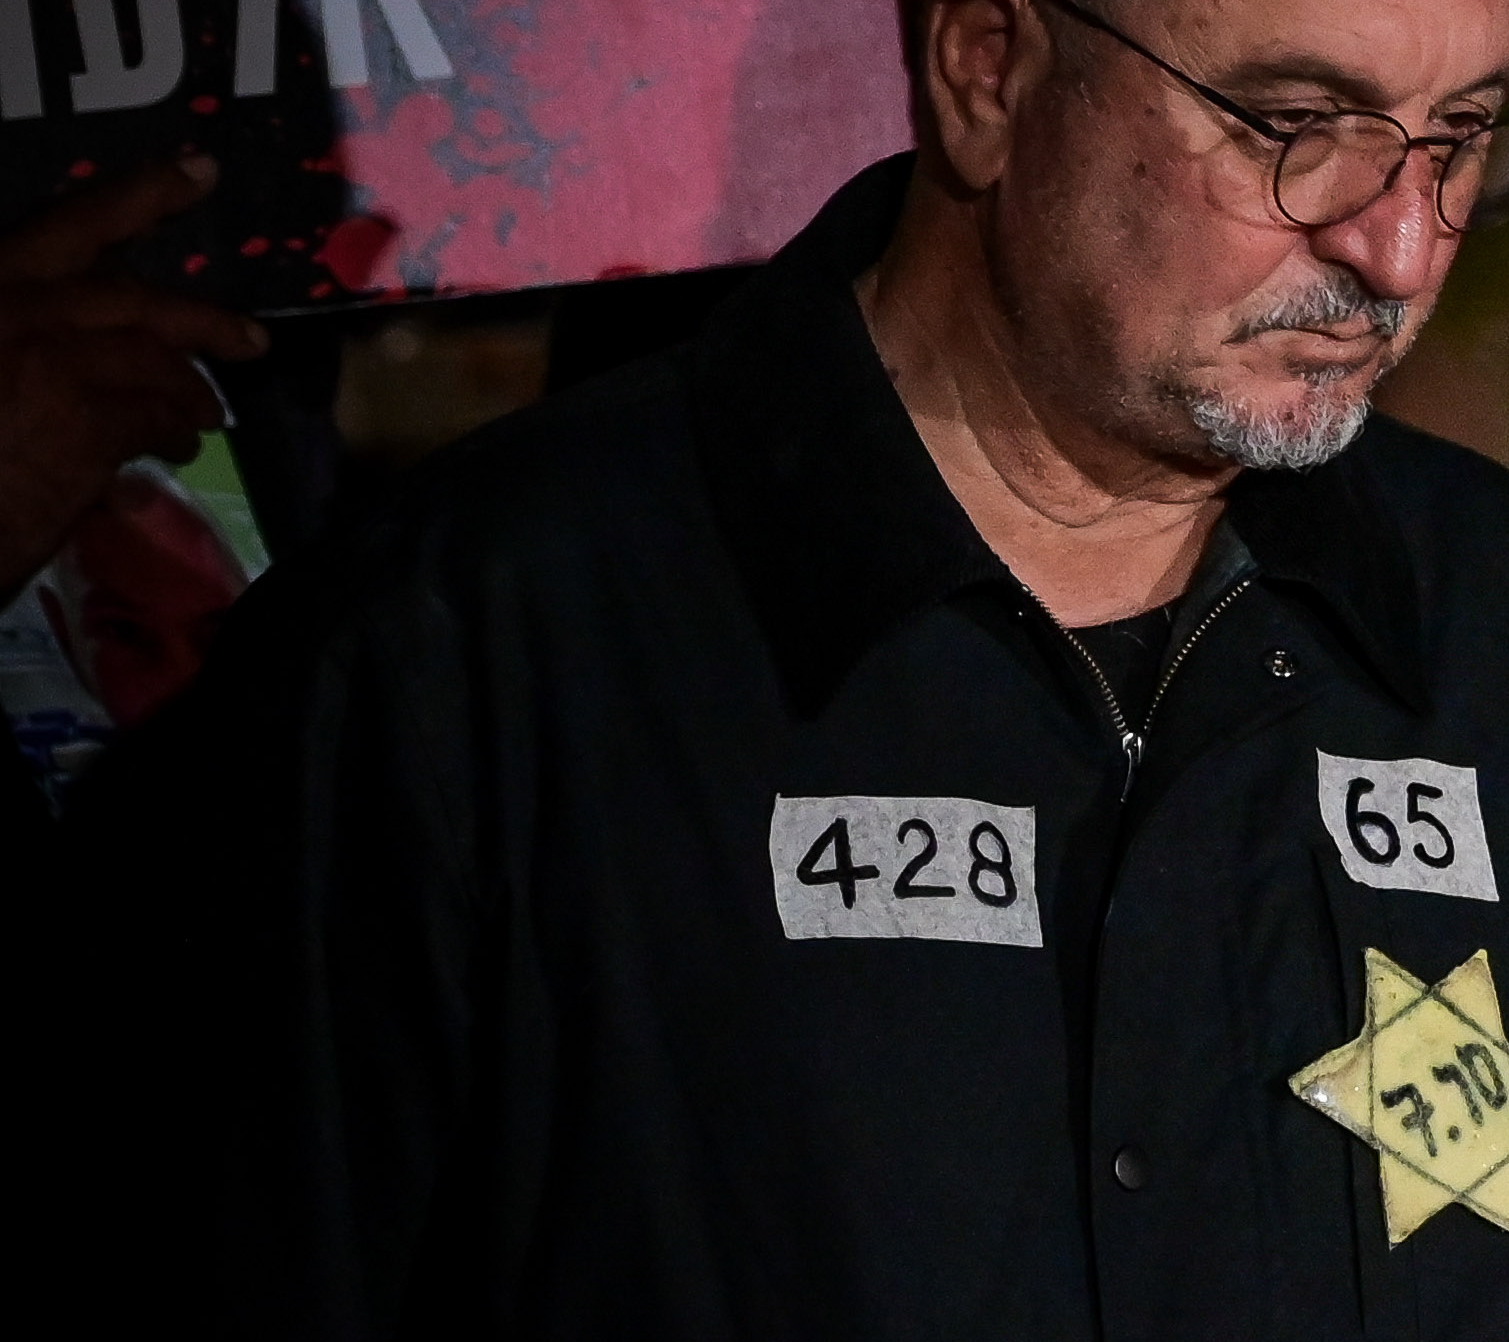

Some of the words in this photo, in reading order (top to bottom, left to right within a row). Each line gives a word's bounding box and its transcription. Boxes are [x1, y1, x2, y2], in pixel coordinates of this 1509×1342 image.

[796, 816, 1018, 910] 428
[1345, 776, 1456, 870] 65
[1380, 1042, 1508, 1158] 7.10
